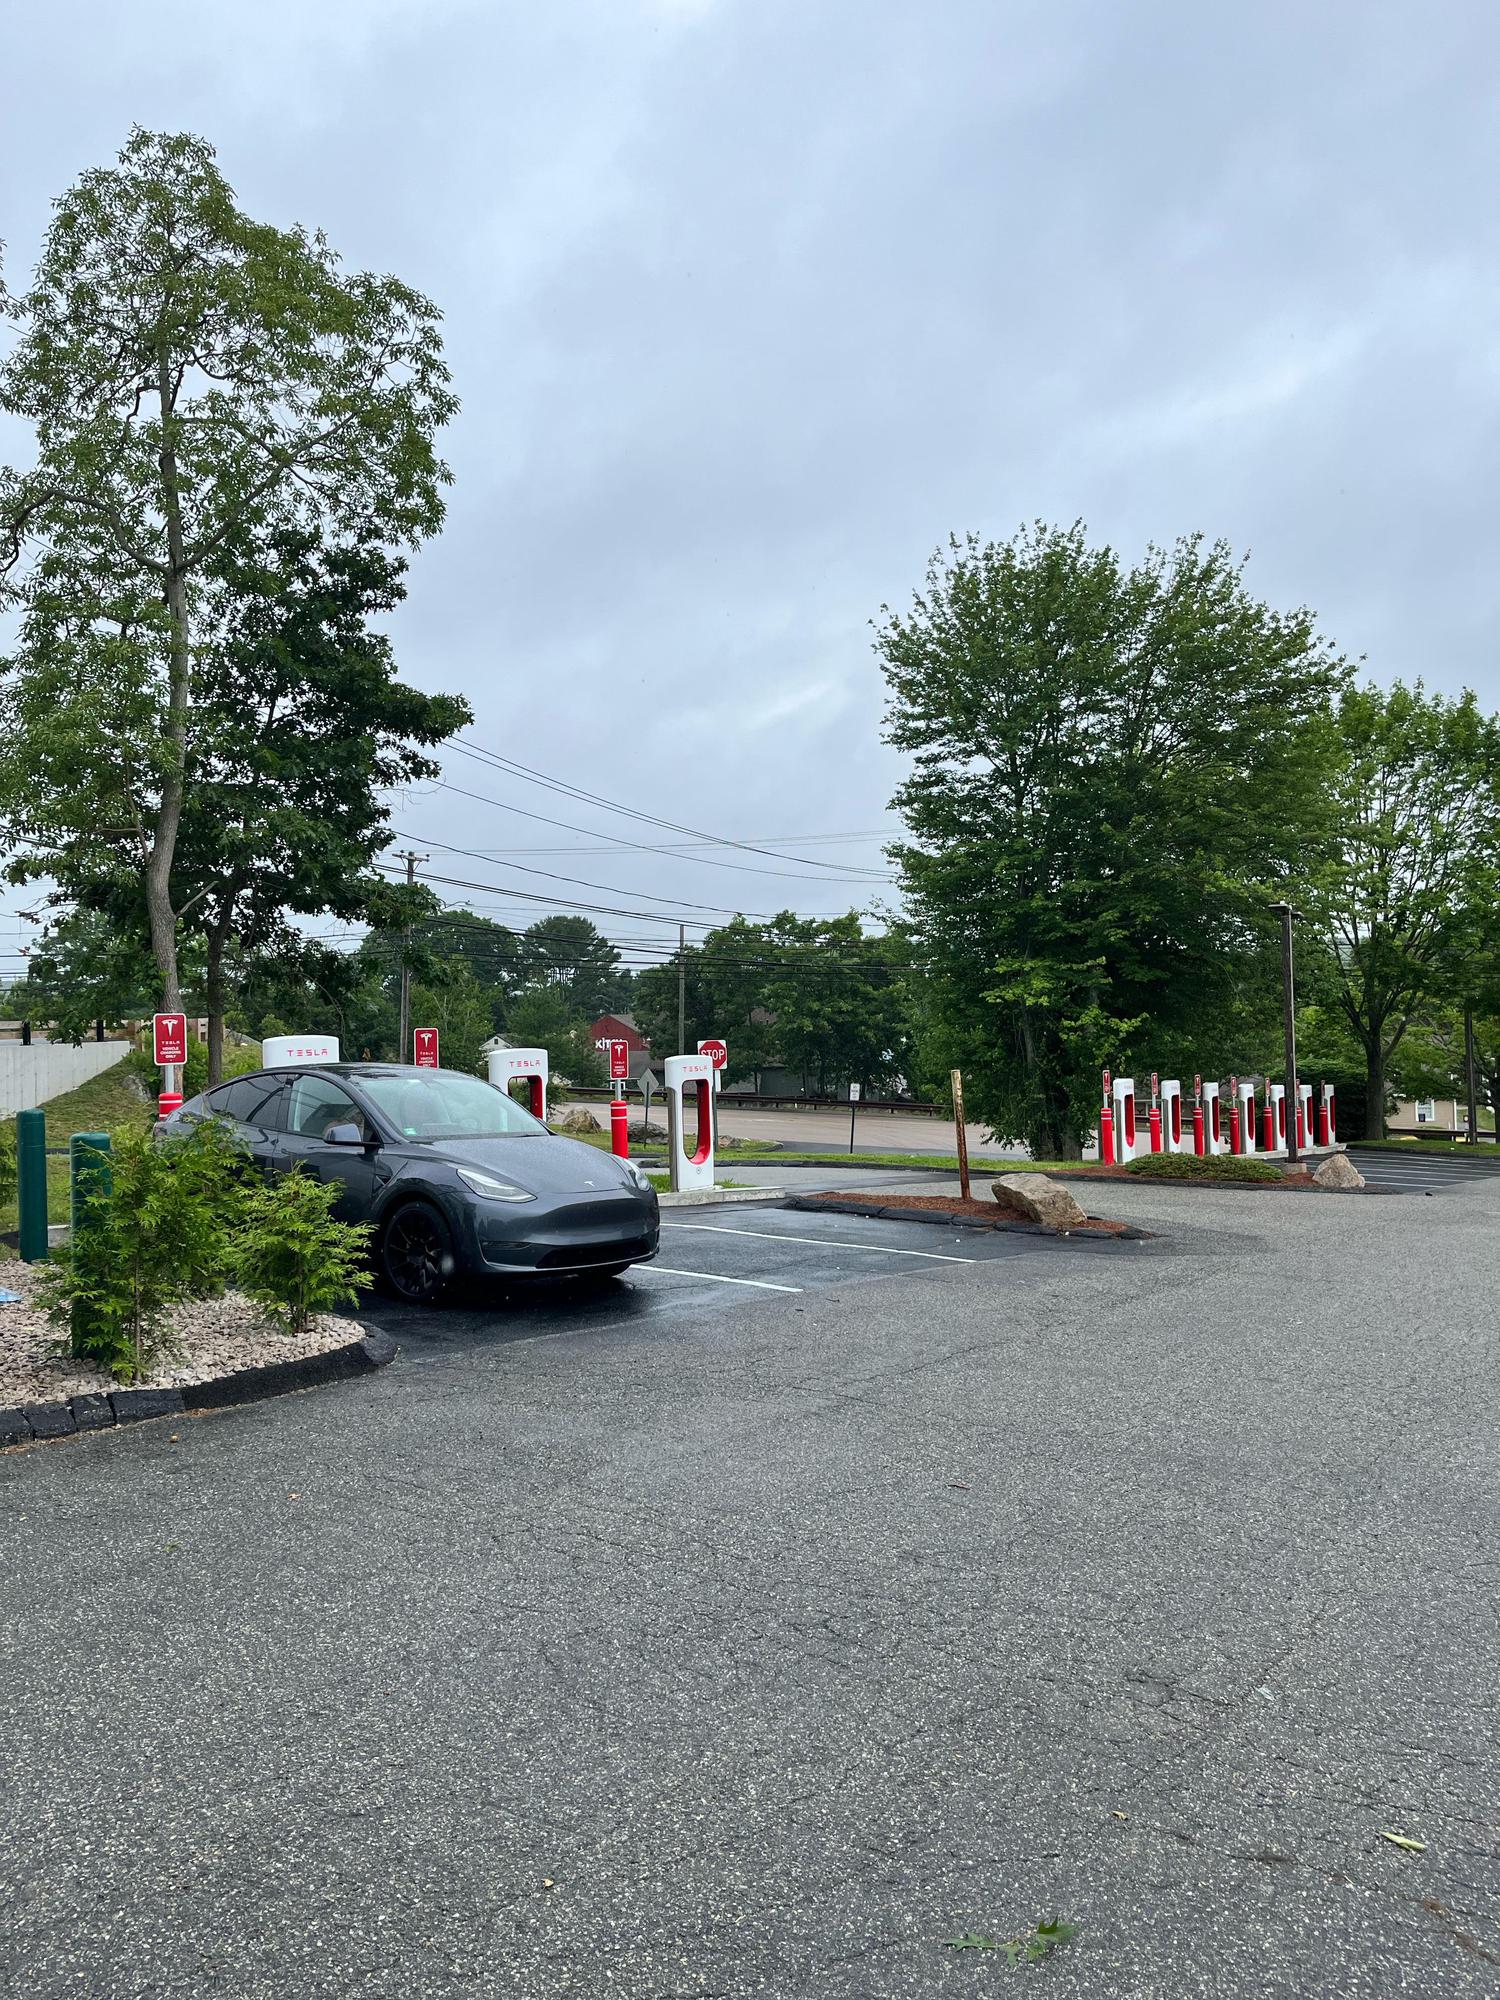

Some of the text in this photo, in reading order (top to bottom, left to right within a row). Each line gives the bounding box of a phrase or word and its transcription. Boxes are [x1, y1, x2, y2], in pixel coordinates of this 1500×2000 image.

[287, 1048, 328, 1057] TESLA
[701, 1049, 725, 1060] STOP
[509, 1060, 541, 1068] TESLA
